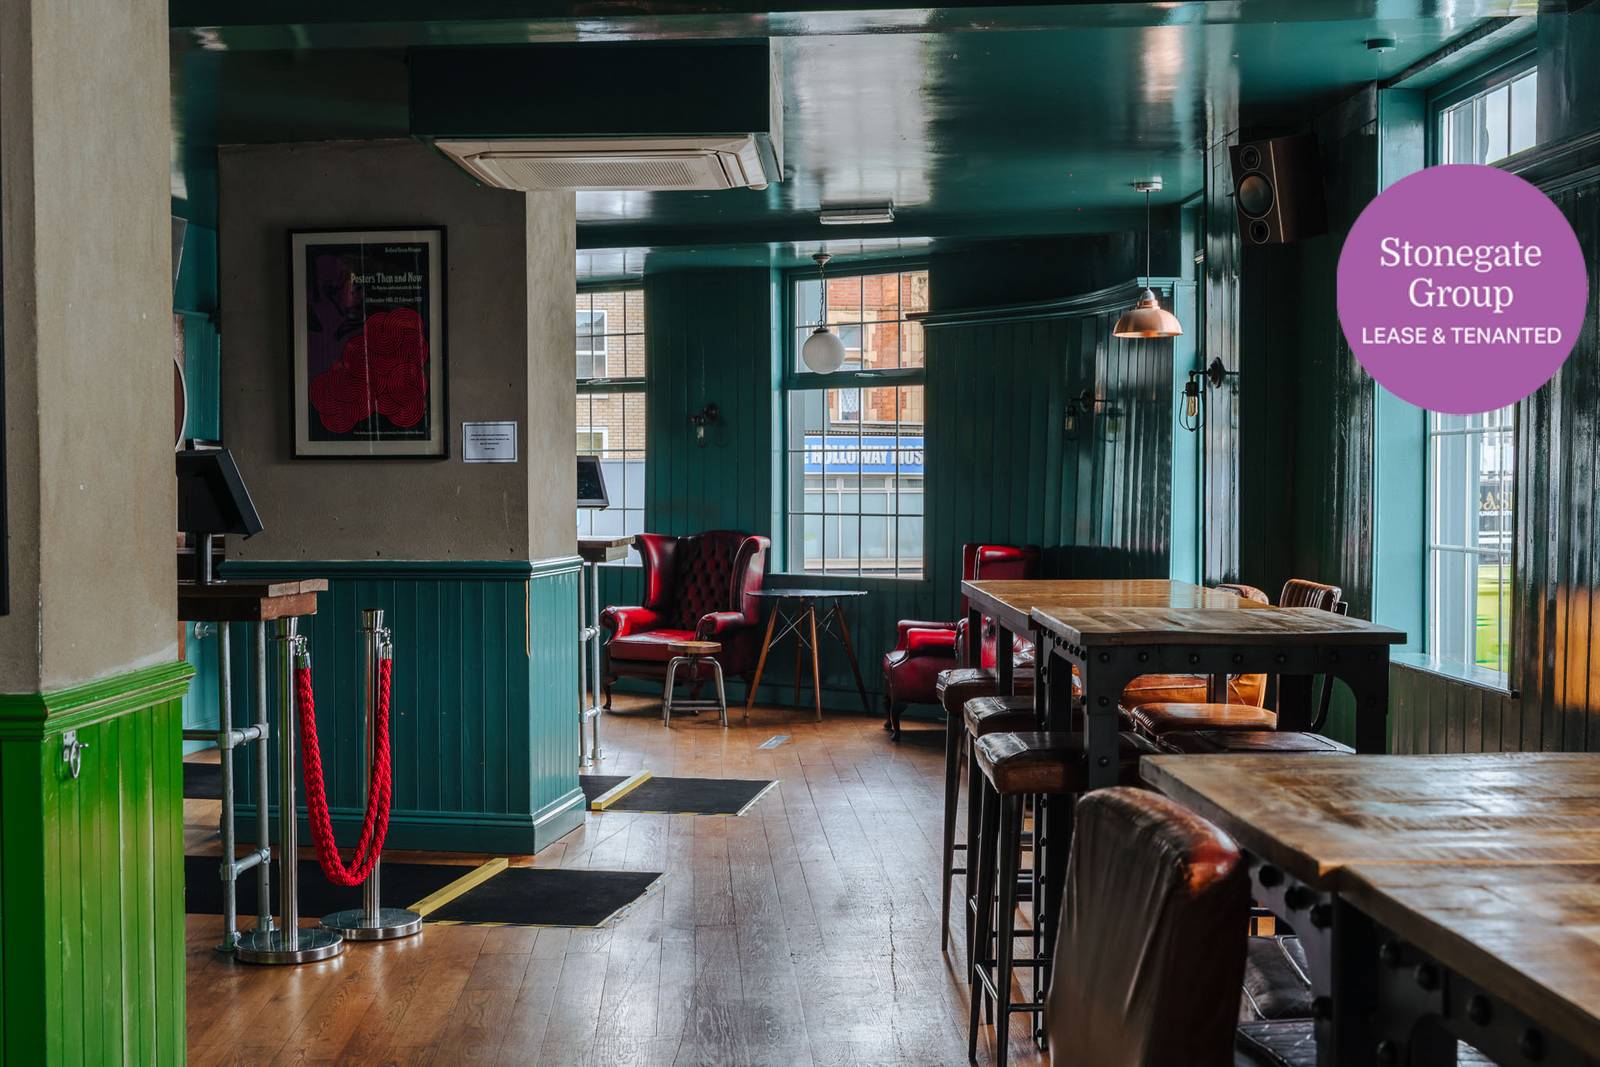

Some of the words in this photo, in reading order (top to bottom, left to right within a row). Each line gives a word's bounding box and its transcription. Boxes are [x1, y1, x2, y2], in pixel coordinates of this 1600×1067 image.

[350, 272, 375, 284] Posters
[376, 272, 393, 284] Then
[394, 272, 406, 283] and
[407, 272, 422, 283] Now
[811, 444, 888, 465] HOLLOWAY
